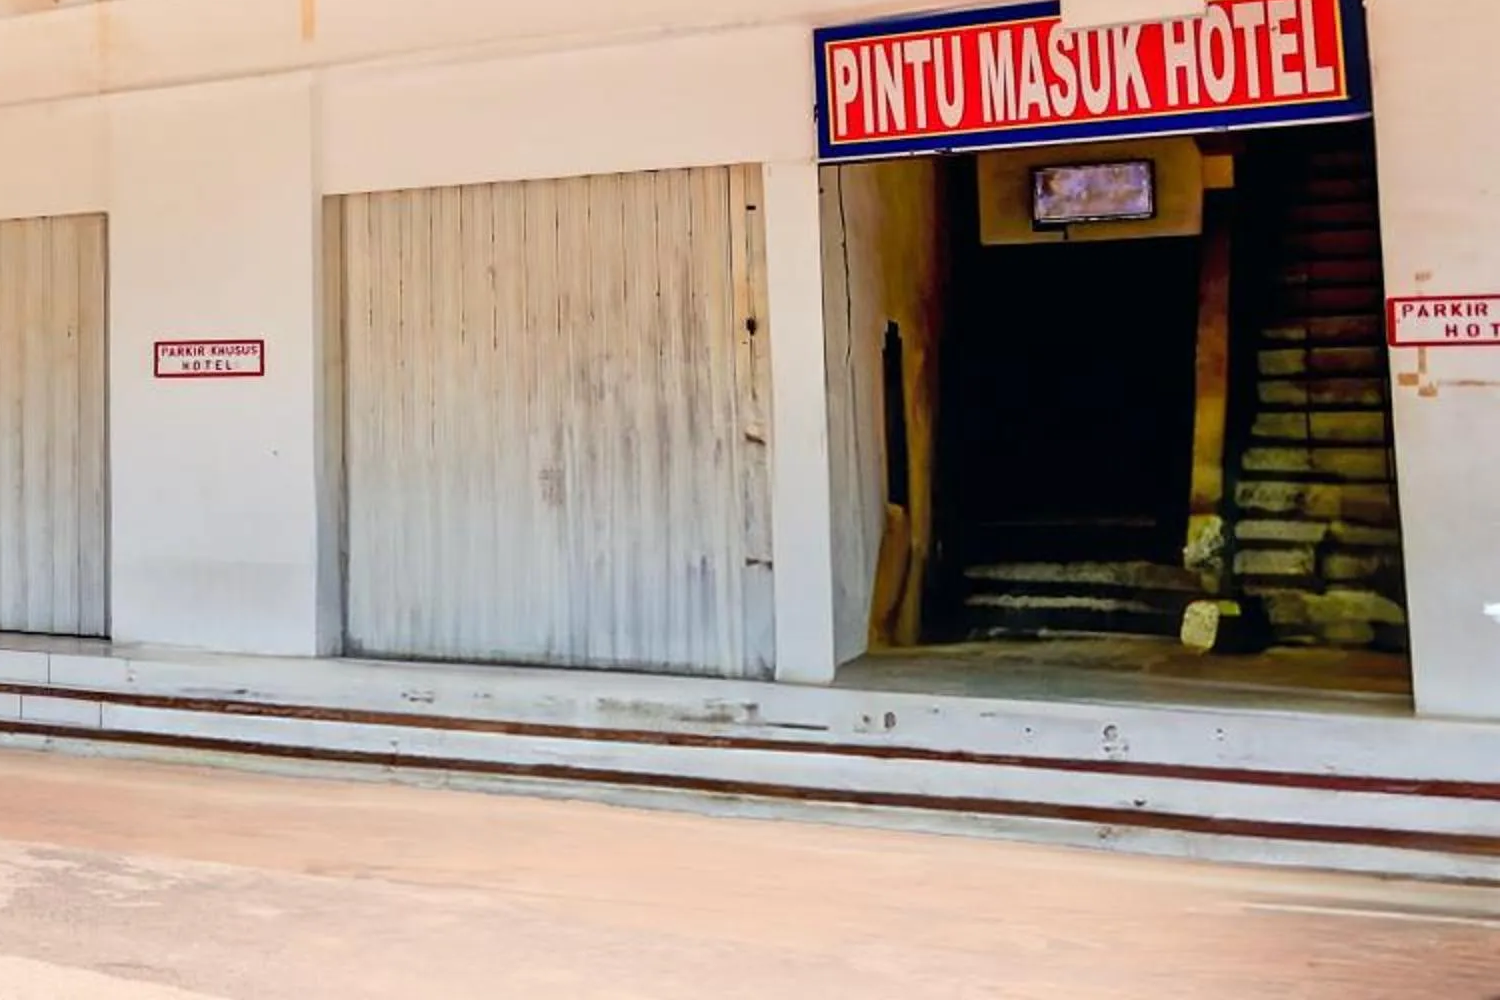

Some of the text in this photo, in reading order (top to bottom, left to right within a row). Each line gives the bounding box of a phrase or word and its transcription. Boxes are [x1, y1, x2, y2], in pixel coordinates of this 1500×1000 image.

[831, 36, 967, 136] PINTU
[977, 18, 1151, 123] MASUK
[1401, 302, 1489, 318] PARKIR
[161, 345, 258, 357] PARKIR KHUSUS
